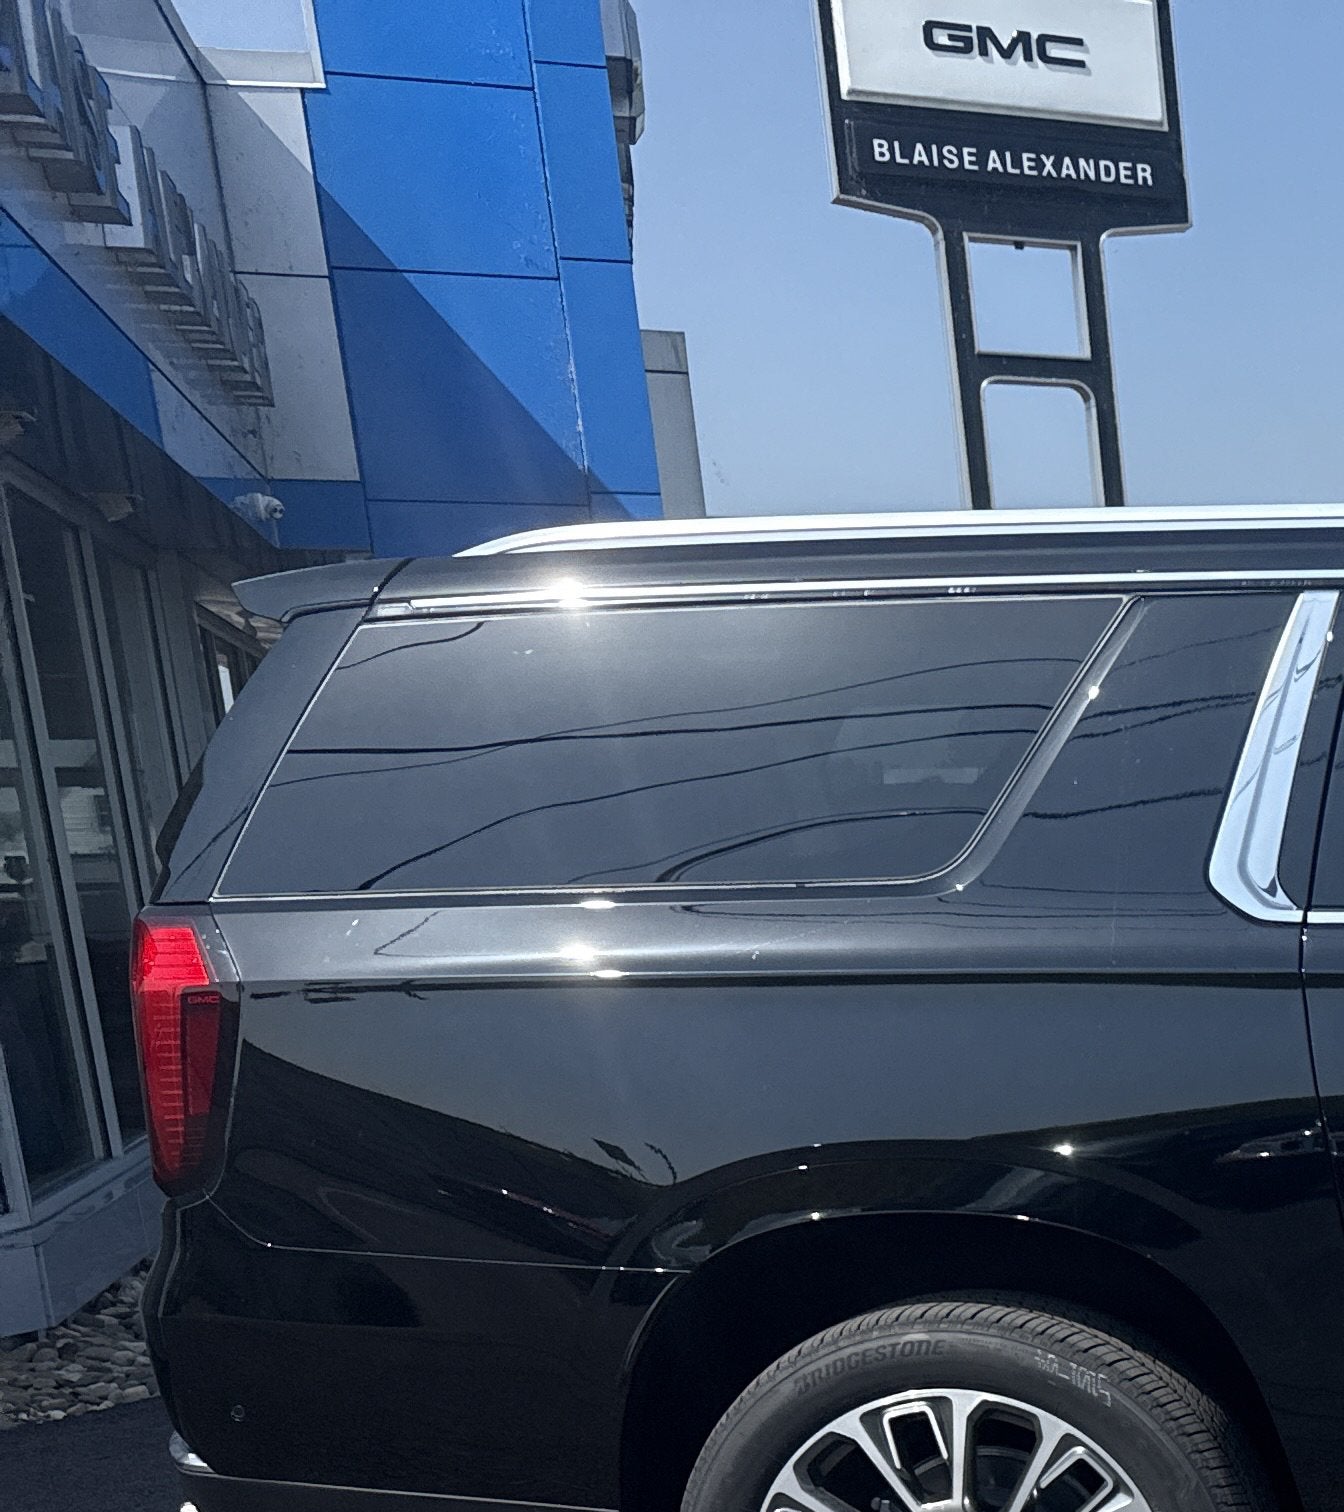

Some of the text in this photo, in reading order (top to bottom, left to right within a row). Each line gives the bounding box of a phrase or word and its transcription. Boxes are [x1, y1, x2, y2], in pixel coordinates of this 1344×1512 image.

[922, 19, 1087, 69] GMC
[872, 138, 1154, 187] BLAISE ALEXANDER
[793, 1339, 947, 1397] BRIDGESTONE
